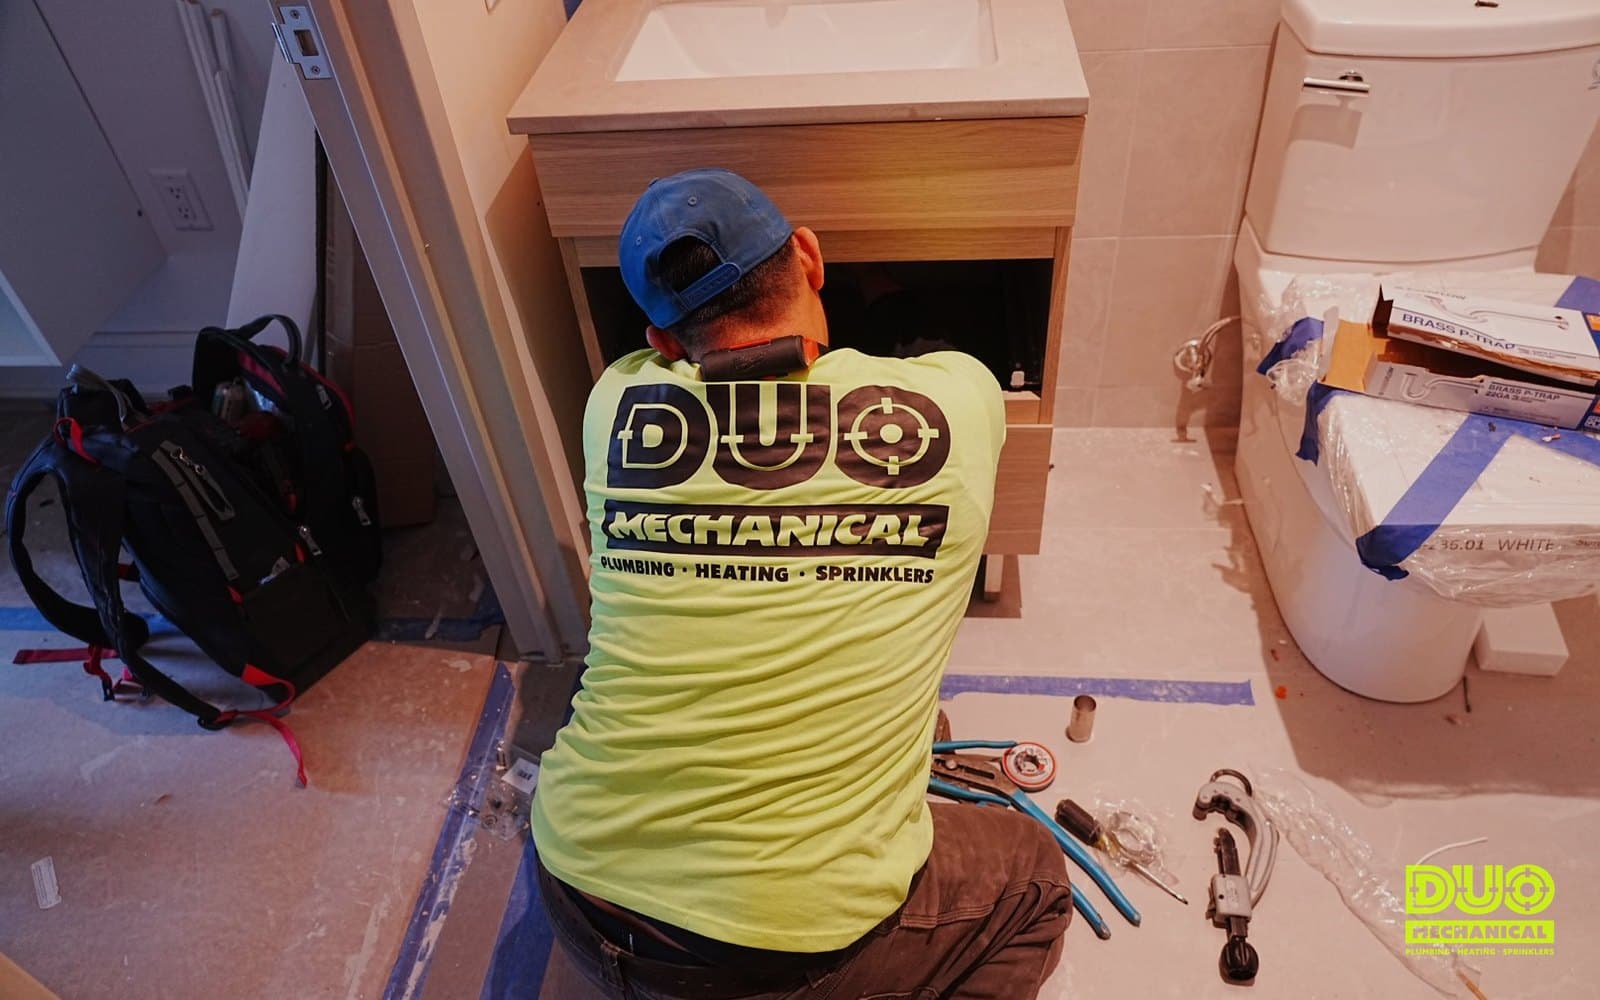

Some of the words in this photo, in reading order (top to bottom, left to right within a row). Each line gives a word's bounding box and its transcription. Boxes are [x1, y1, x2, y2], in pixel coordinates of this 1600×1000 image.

[1402, 313, 1456, 335] BRASS
[1459, 328, 1516, 350] P-TRAP
[1488, 384, 1522, 394] BRASS
[1523, 389, 1561, 401] P-TRAP
[606, 384, 952, 490] DUO
[608, 511, 929, 547] MECHANICAL
[1498, 538, 1555, 551] WHITE
[601, 556, 675, 577] PLUMBING
[695, 563, 789, 582] HEATING
[816, 566, 934, 584] SPRINKLERS
